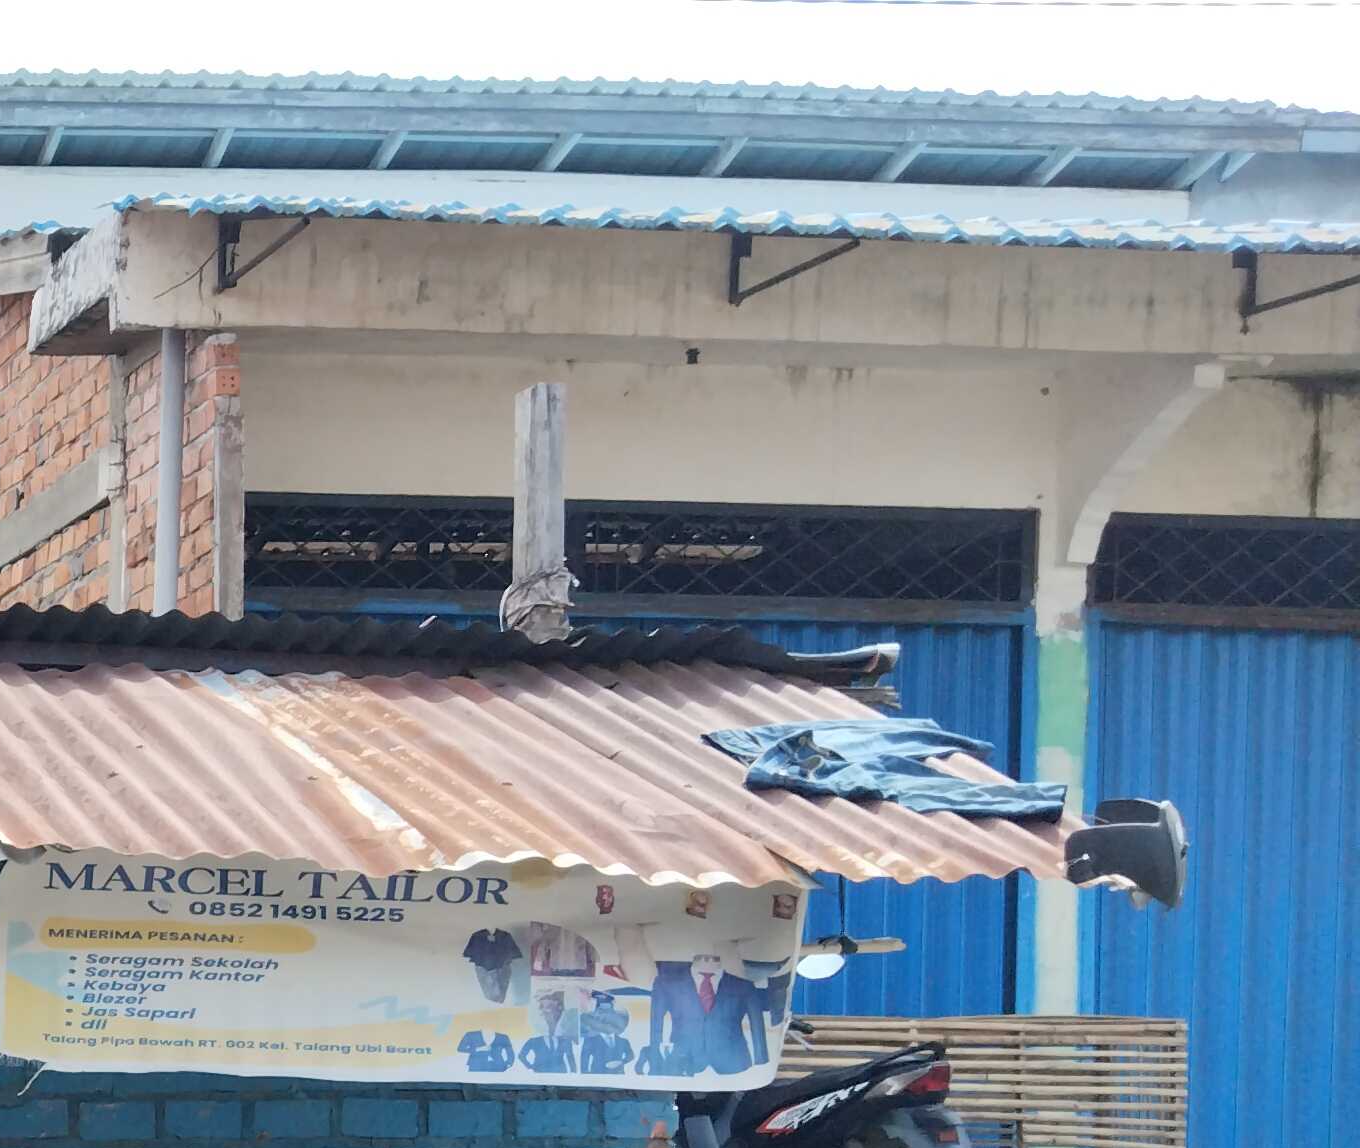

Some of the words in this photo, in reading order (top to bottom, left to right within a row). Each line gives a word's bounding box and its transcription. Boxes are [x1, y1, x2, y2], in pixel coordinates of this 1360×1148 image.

[43, 862, 283, 897] MARCEL
[298, 870, 509, 906] TAILOR
[189, 901, 263, 918] 0852
[270, 904, 327, 921] 1491
[336, 906, 405, 923] 5225
[48, 928, 143, 941] MENERIMA
[147, 930, 234, 944] PESANAN
[85, 953, 184, 969] Seragam
[191, 956, 279, 971] Sekolah
[84, 966, 183, 982] Seragam
[189, 969, 265, 983] Kantor
[83, 980, 166, 994] Kebaya
[81, 1006, 118, 1017] Jas
